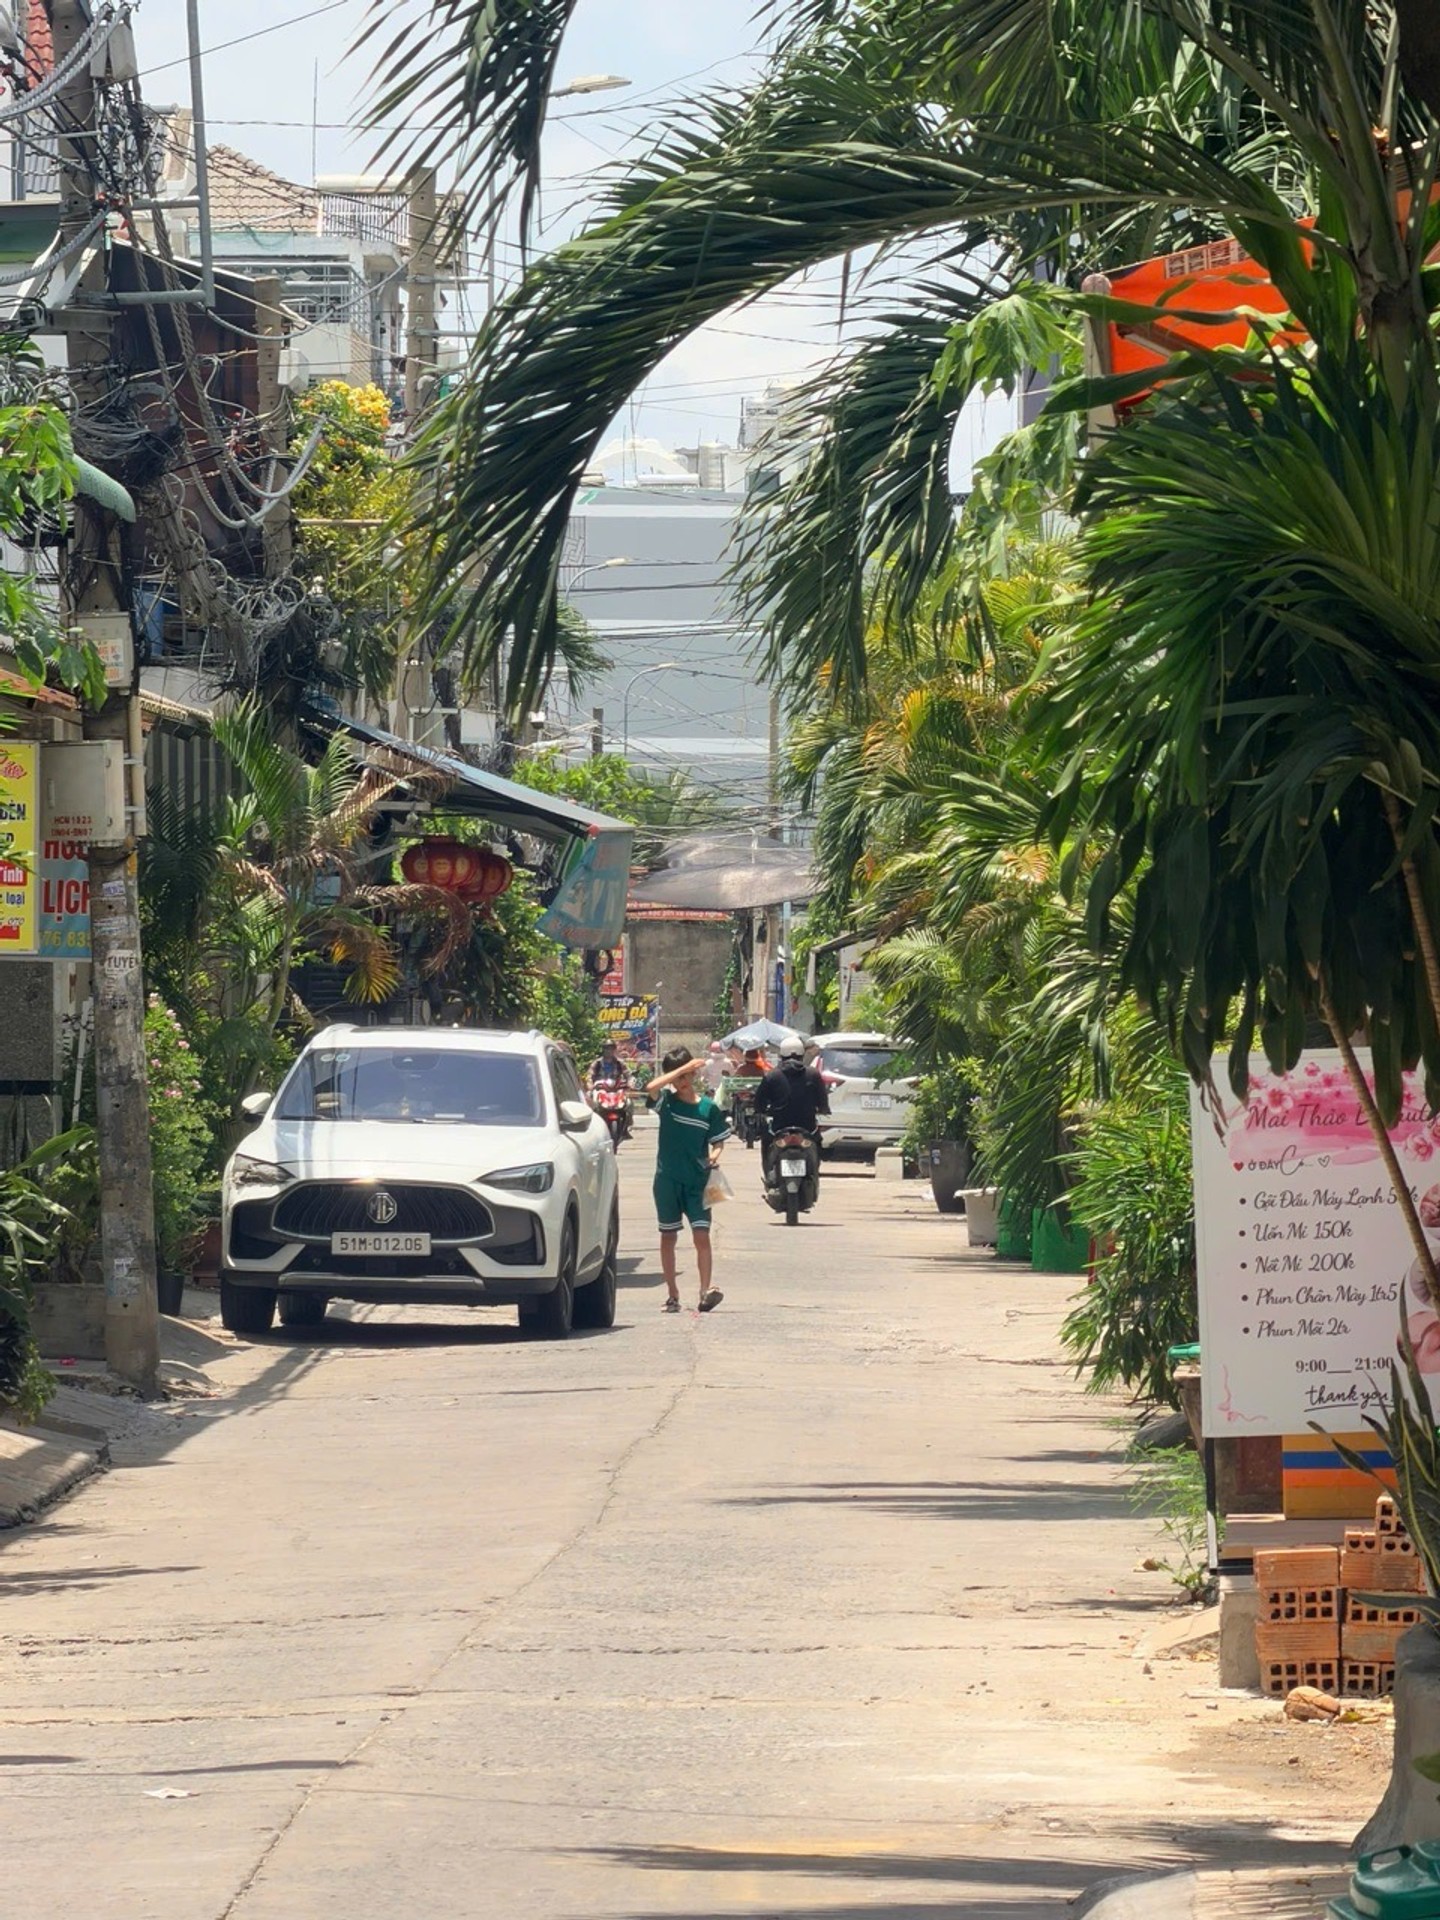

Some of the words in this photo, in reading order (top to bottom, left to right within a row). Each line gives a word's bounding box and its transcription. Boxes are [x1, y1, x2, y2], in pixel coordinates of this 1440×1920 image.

[1246, 1105, 1289, 1130] Mai
[1311, 1188, 1344, 1210] Máy
[1345, 1186, 1384, 1209] Lạnh
[1313, 1220, 1353, 1241] 150k
[1308, 1252, 1356, 1272] 200k
[1255, 1287, 1294, 1306] Phun
[1295, 1284, 1333, 1305] Chân
[1257, 1319, 1295, 1339] Phun
[1304, 1384, 1358, 1406] thank
